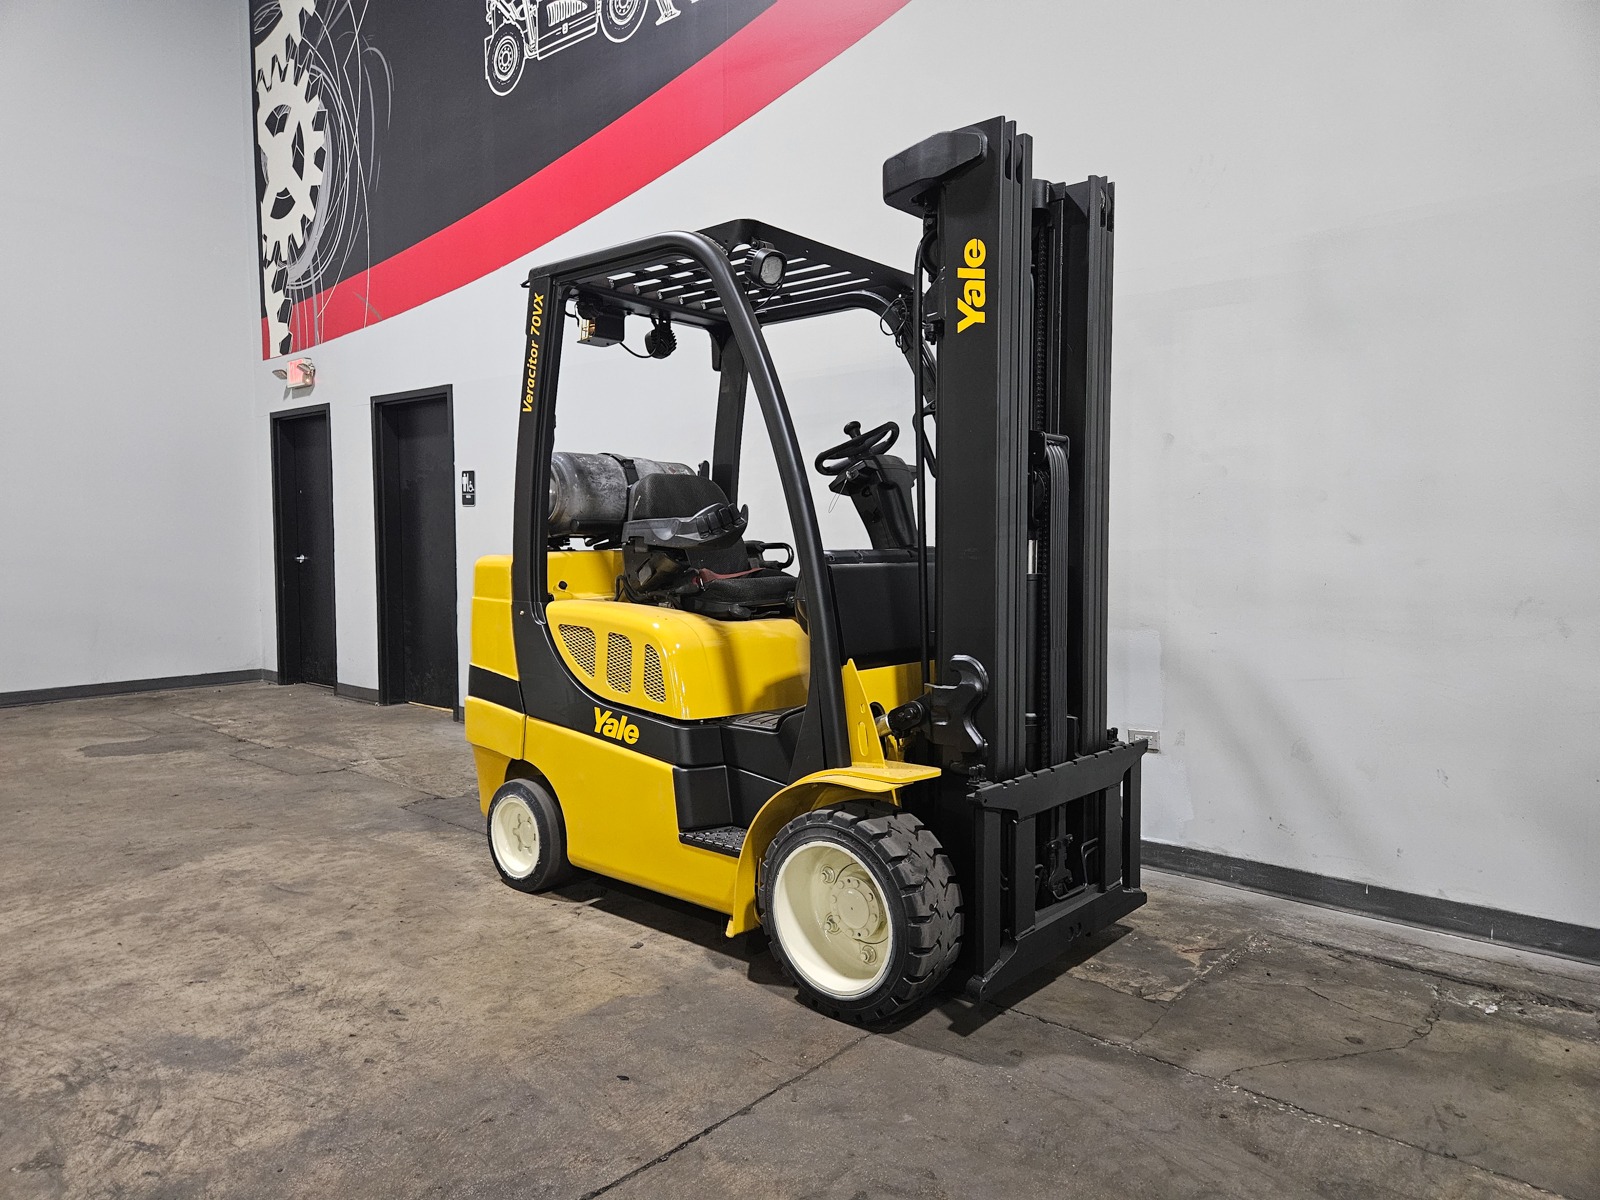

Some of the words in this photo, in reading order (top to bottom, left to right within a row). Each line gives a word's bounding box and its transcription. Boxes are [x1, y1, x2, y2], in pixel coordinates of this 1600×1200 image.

[530, 292, 545, 336] 70VX
[956, 238, 987, 333] Yale
[522, 340, 539, 413] Veracitor
[594, 707, 640, 744] Yale
